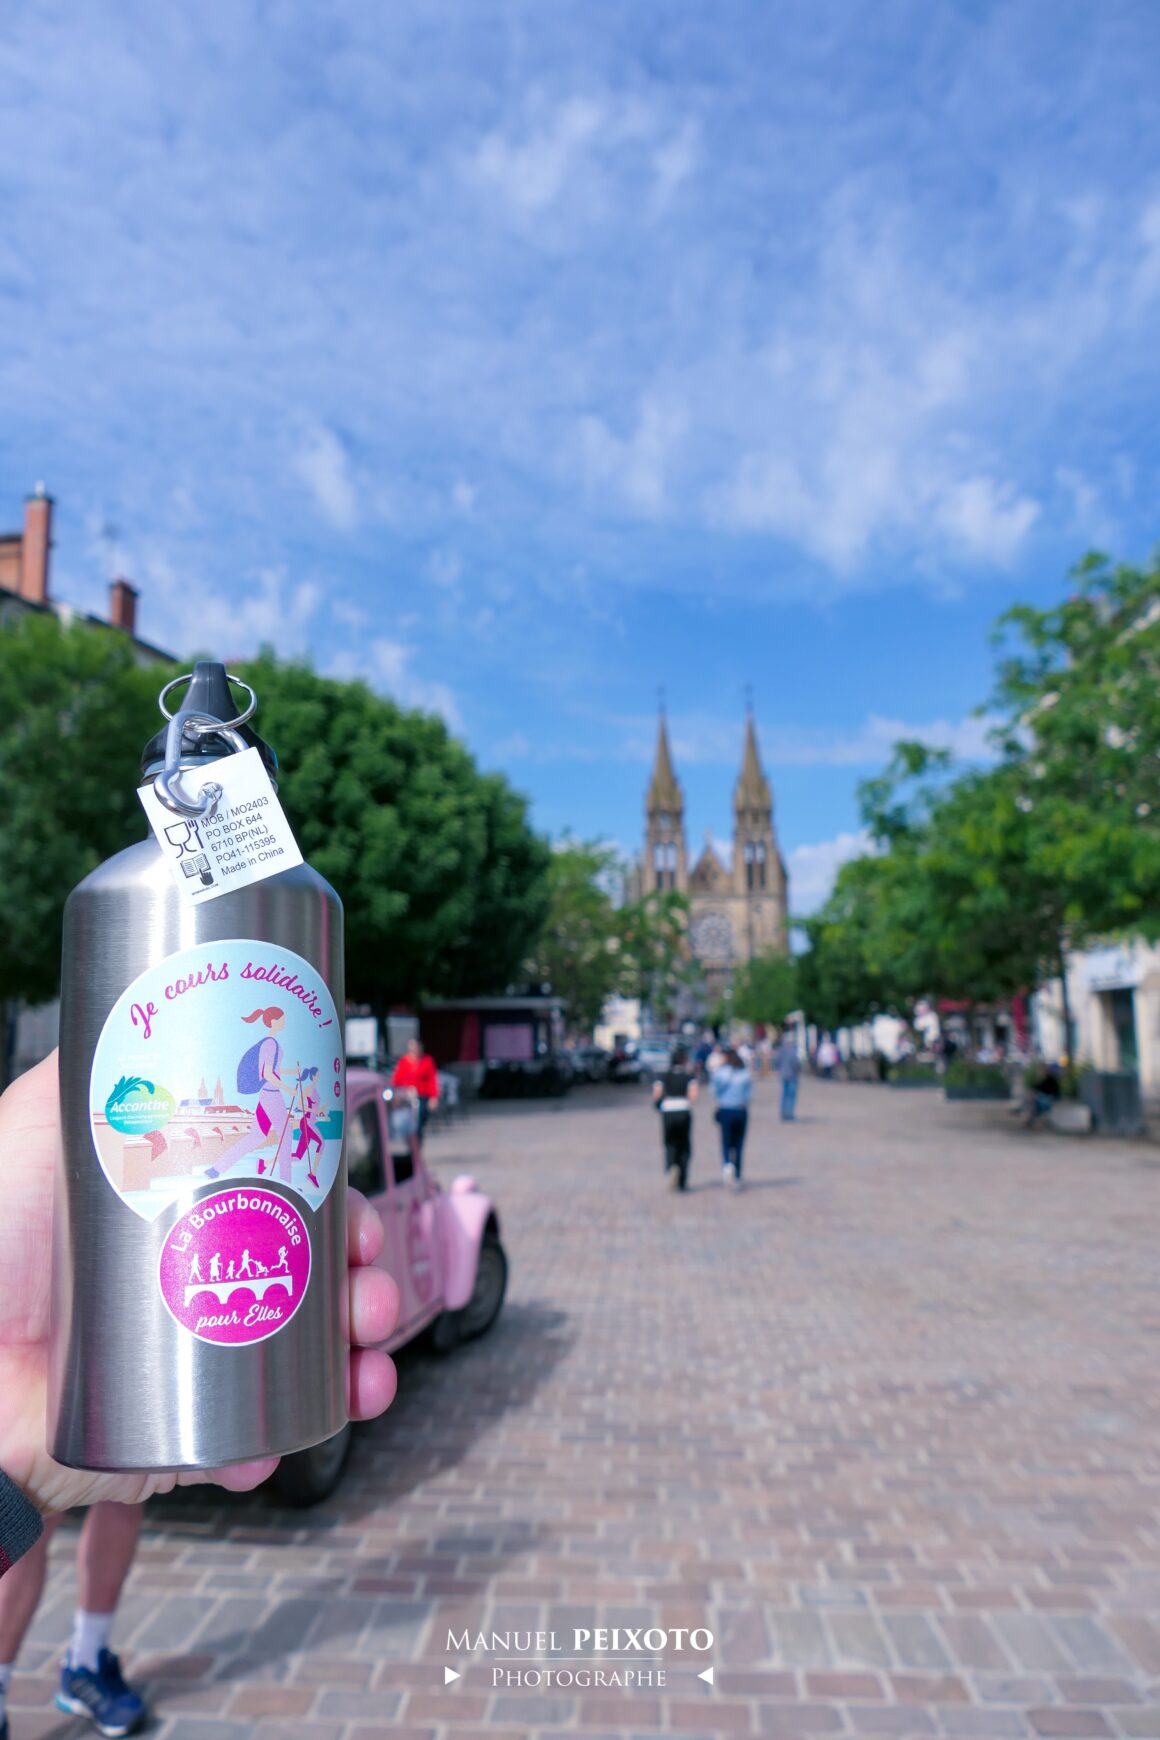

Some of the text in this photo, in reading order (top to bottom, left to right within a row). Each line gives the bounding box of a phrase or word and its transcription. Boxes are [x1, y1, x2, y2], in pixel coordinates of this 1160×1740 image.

[201, 813, 225, 828] MOB
[230, 796, 270, 817] MO2403
[206, 812, 263, 840] PO BOX 644
[211, 824, 269, 851] 6710 BP(NL)
[216, 834, 277, 864] PO41-115395
[221, 847, 285, 876] Made in China
[130, 1001, 159, 1039] Je
[164, 962, 230, 1000] cours
[170, 1193, 301, 1252] La Bourbonnaise
[195, 1303, 283, 1333] pour Elles
